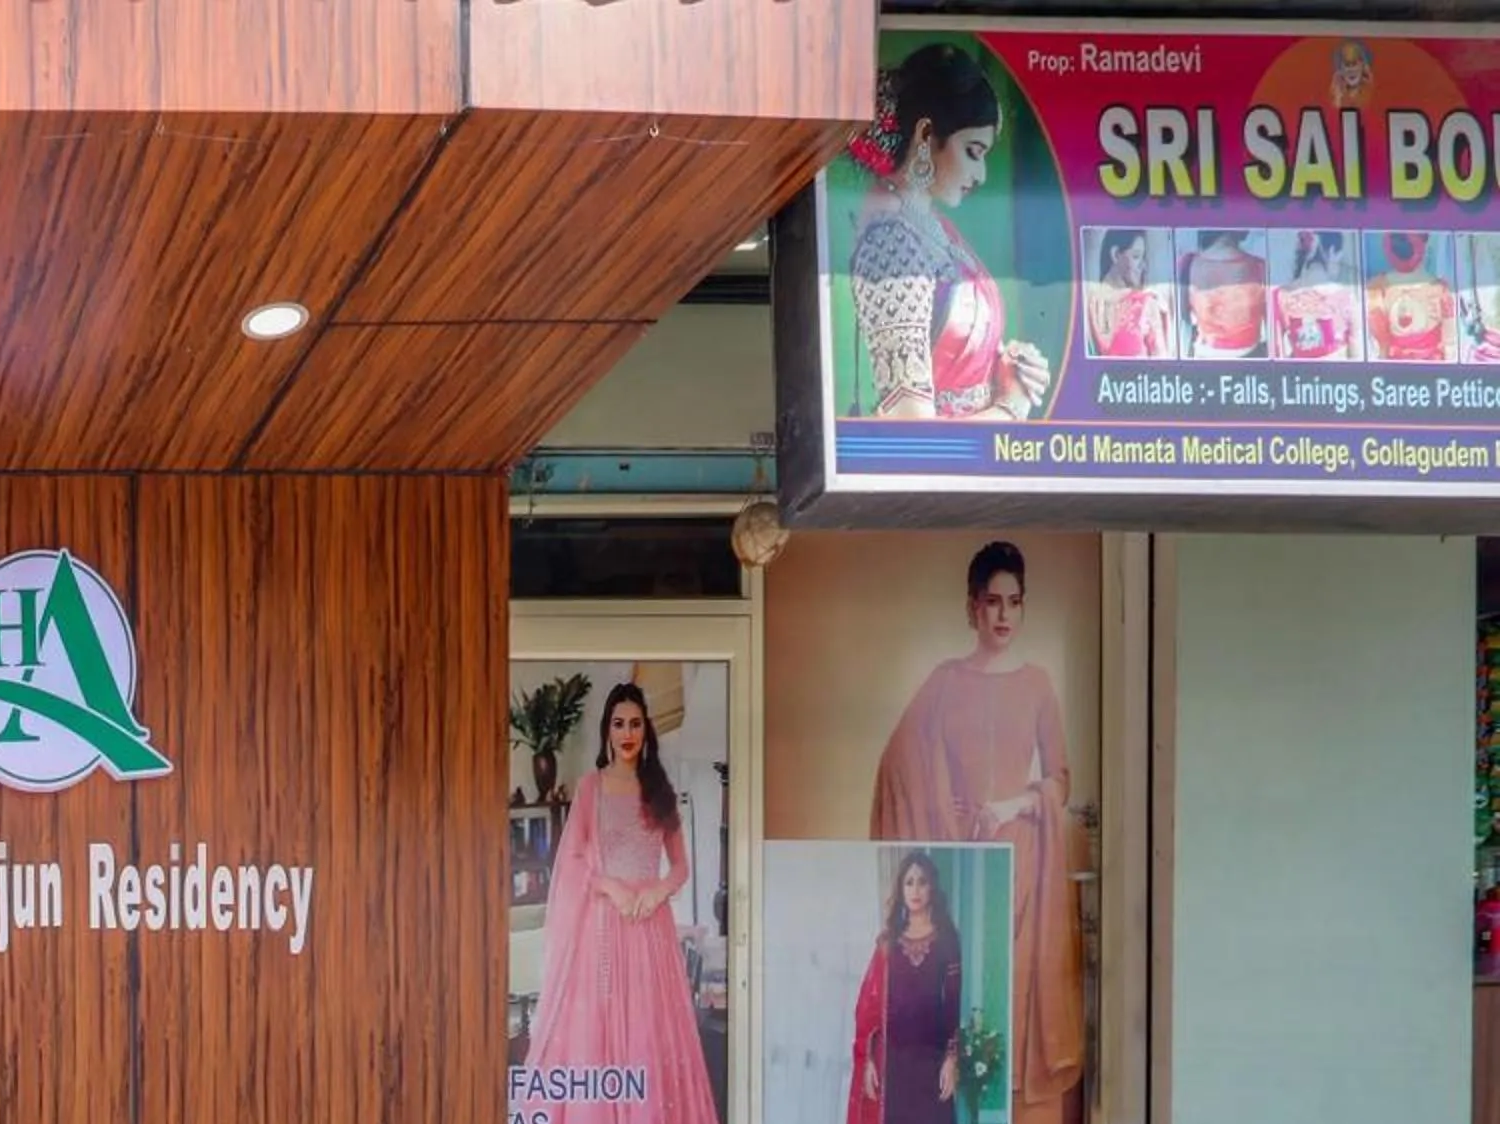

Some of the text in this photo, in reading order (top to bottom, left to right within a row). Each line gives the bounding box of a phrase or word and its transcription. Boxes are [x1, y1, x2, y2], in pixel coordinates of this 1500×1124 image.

[1027, 42, 1202, 77] Prop: Ramadevi
[1099, 105, 1216, 198] SRI
[1243, 106, 1361, 199] SAI
[1098, 374, 1193, 404] Available
[1219, 376, 1275, 412] Falls,
[1282, 376, 1365, 413] Linings,
[1371, 376, 1430, 407] Saree
[994, 433, 1044, 462] Near
[1050, 434, 1087, 463] Old
[1093, 435, 1176, 464] Mamata
[1182, 436, 1263, 465] Medical
[1269, 437, 1355, 471] College,
[1361, 438, 1488, 474] Gollagudem
[88, 843, 313, 954] Residency
[510, 1069, 645, 1100] FASHION
